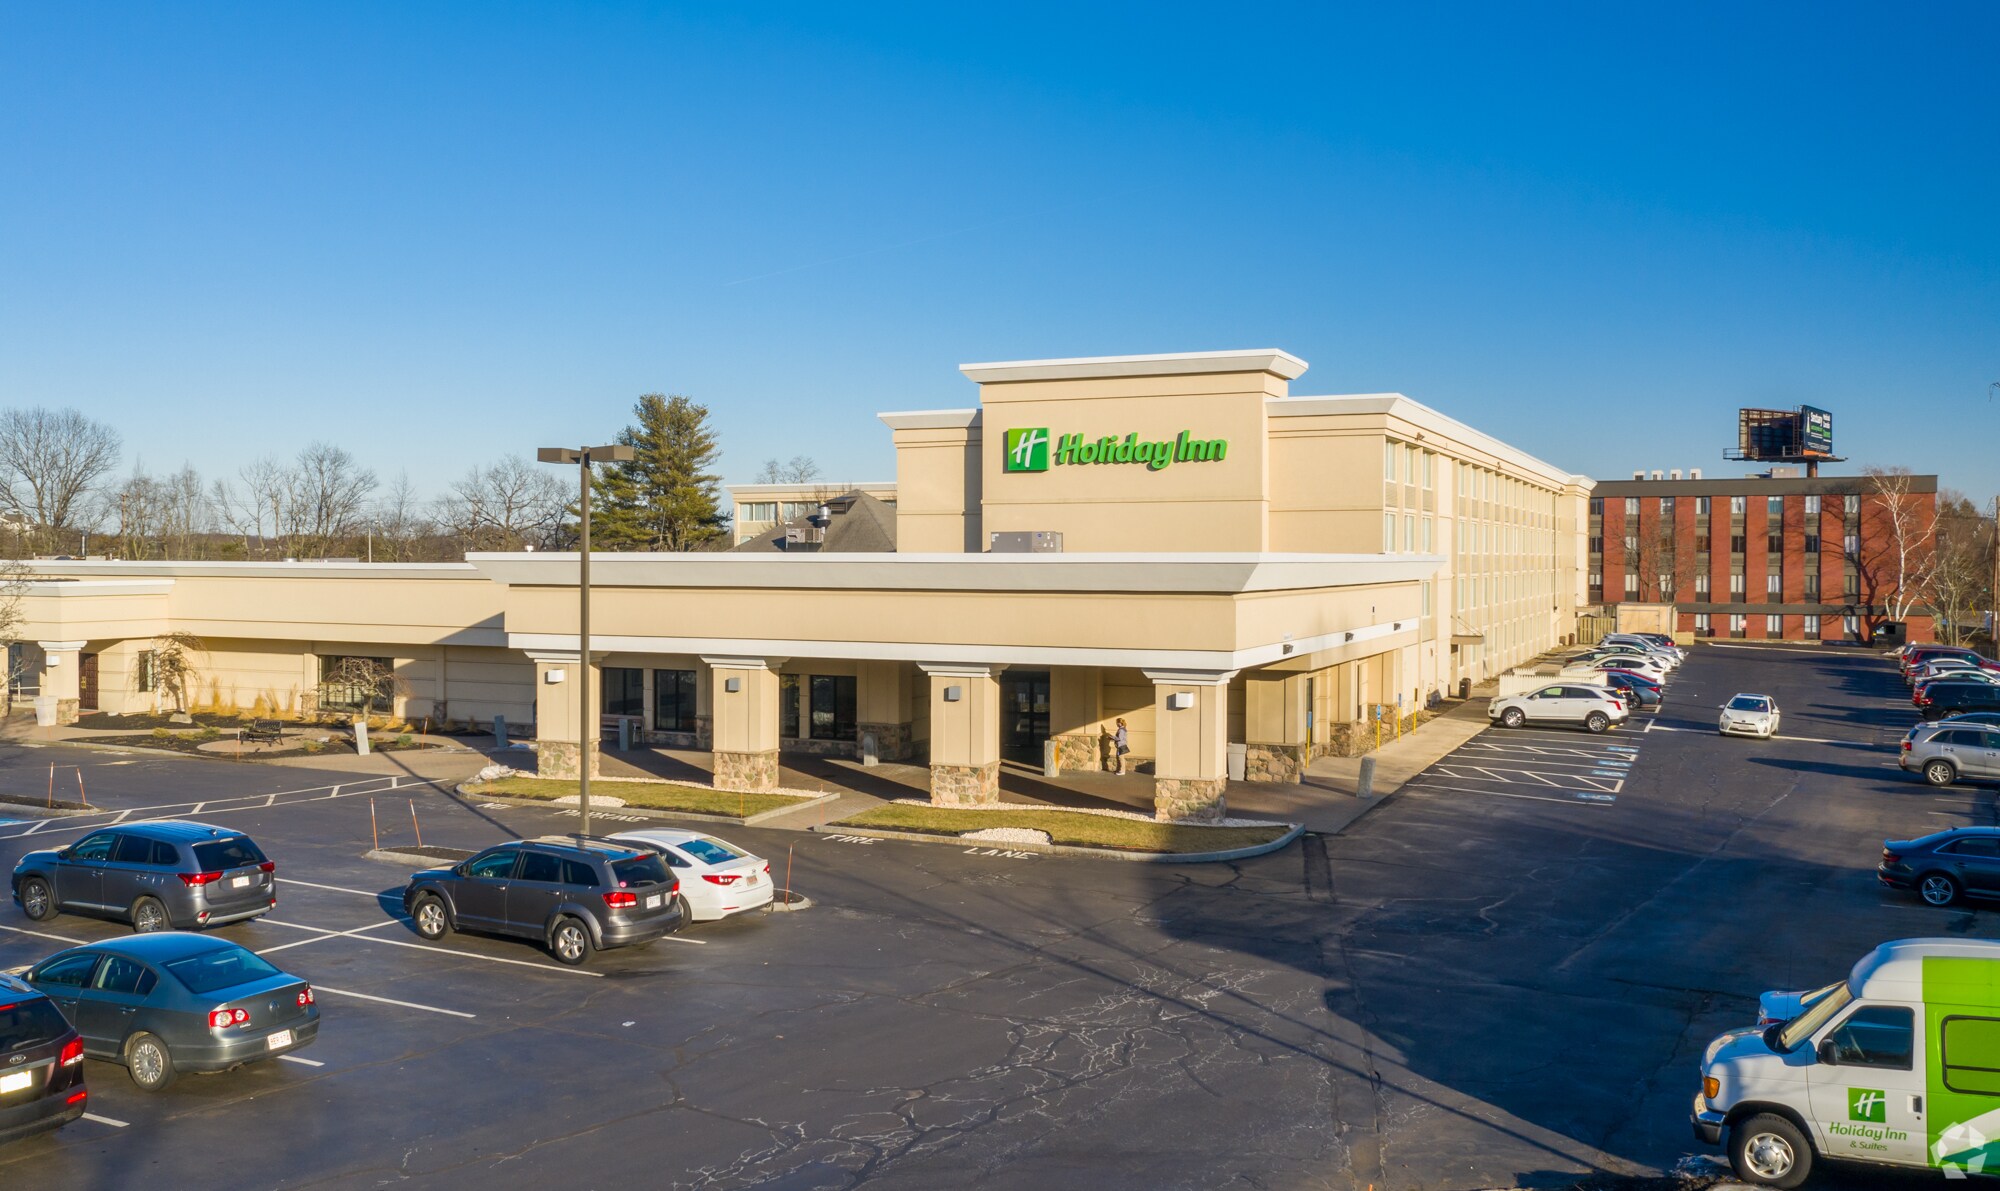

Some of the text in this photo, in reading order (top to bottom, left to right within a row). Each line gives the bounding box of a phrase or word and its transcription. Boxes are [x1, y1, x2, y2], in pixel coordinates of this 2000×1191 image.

[1055, 432, 1174, 469] Holiday
[1177, 430, 1228, 461] Inn
[476, 802, 512, 810] NO
[821, 834, 884, 845] FIRE
[962, 847, 1039, 860] LANE
[1829, 1121, 1907, 1141] Holiday Inn
[1850, 1140, 1888, 1151] & Suites
